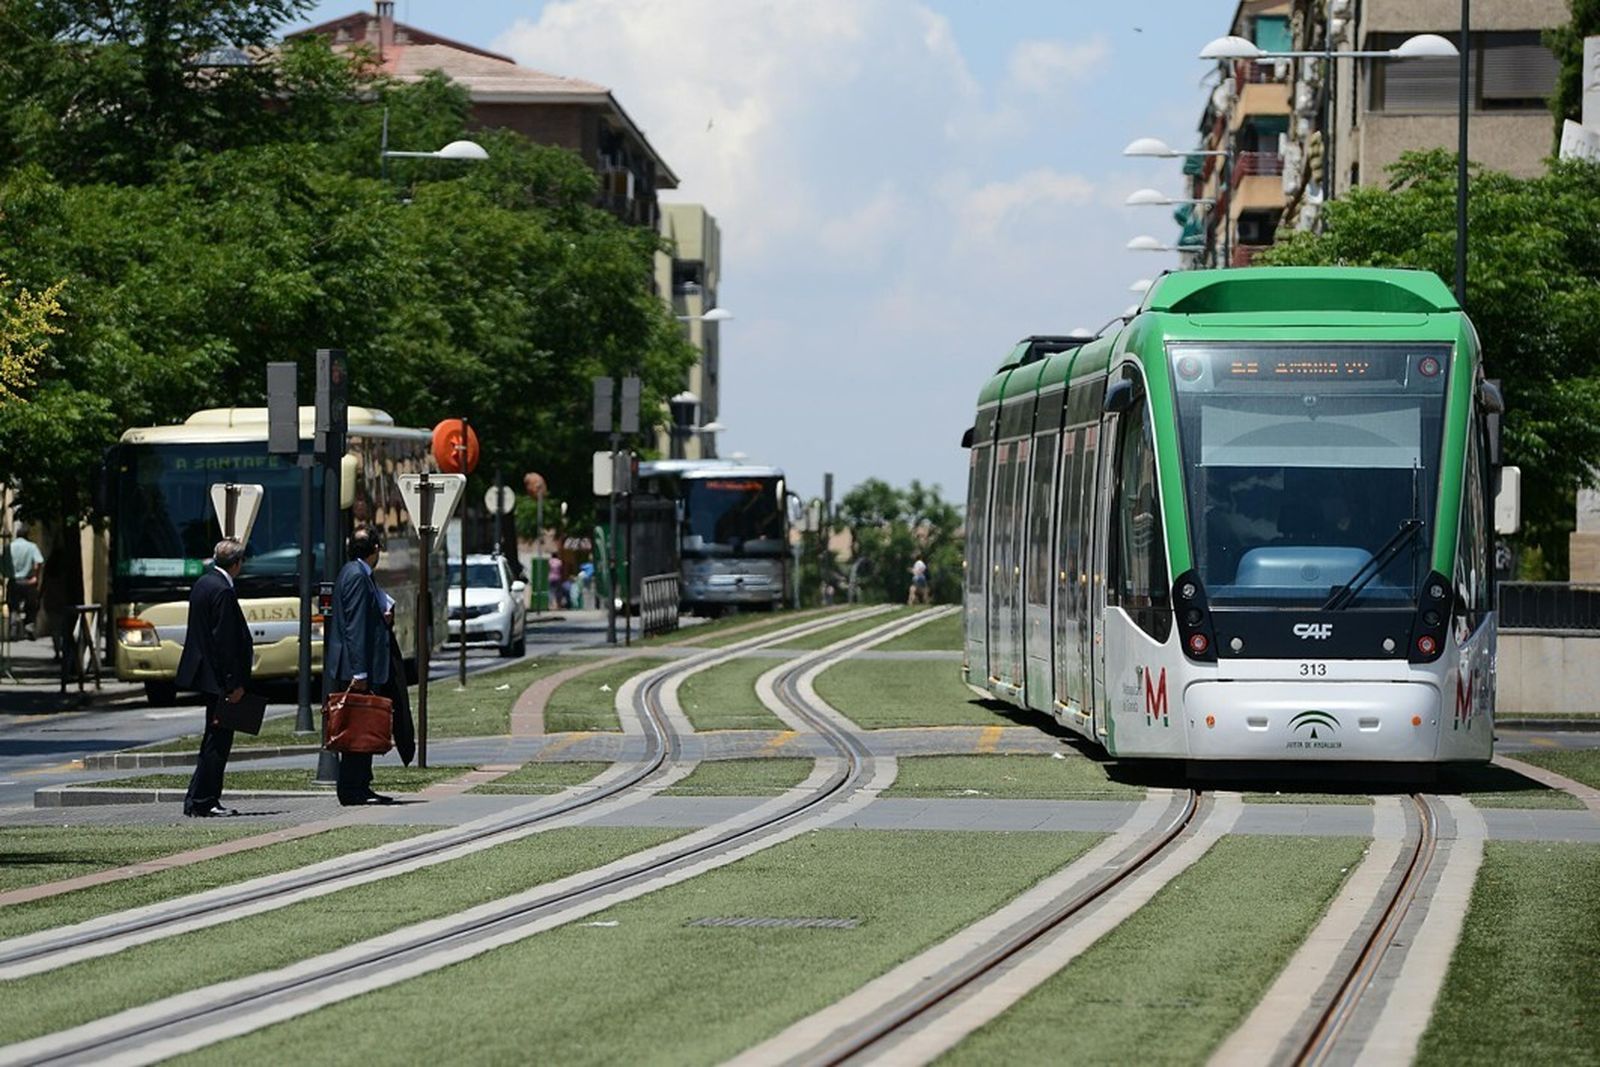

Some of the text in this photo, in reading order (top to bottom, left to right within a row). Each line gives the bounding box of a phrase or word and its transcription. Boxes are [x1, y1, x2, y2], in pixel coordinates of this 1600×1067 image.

[176, 458, 187, 469] A
[247, 607, 297, 620] ALSA
[1293, 623, 1333, 639] CAF
[1300, 663, 1327, 676] 313
[1145, 666, 1168, 727] M
[1454, 669, 1473, 730] M
